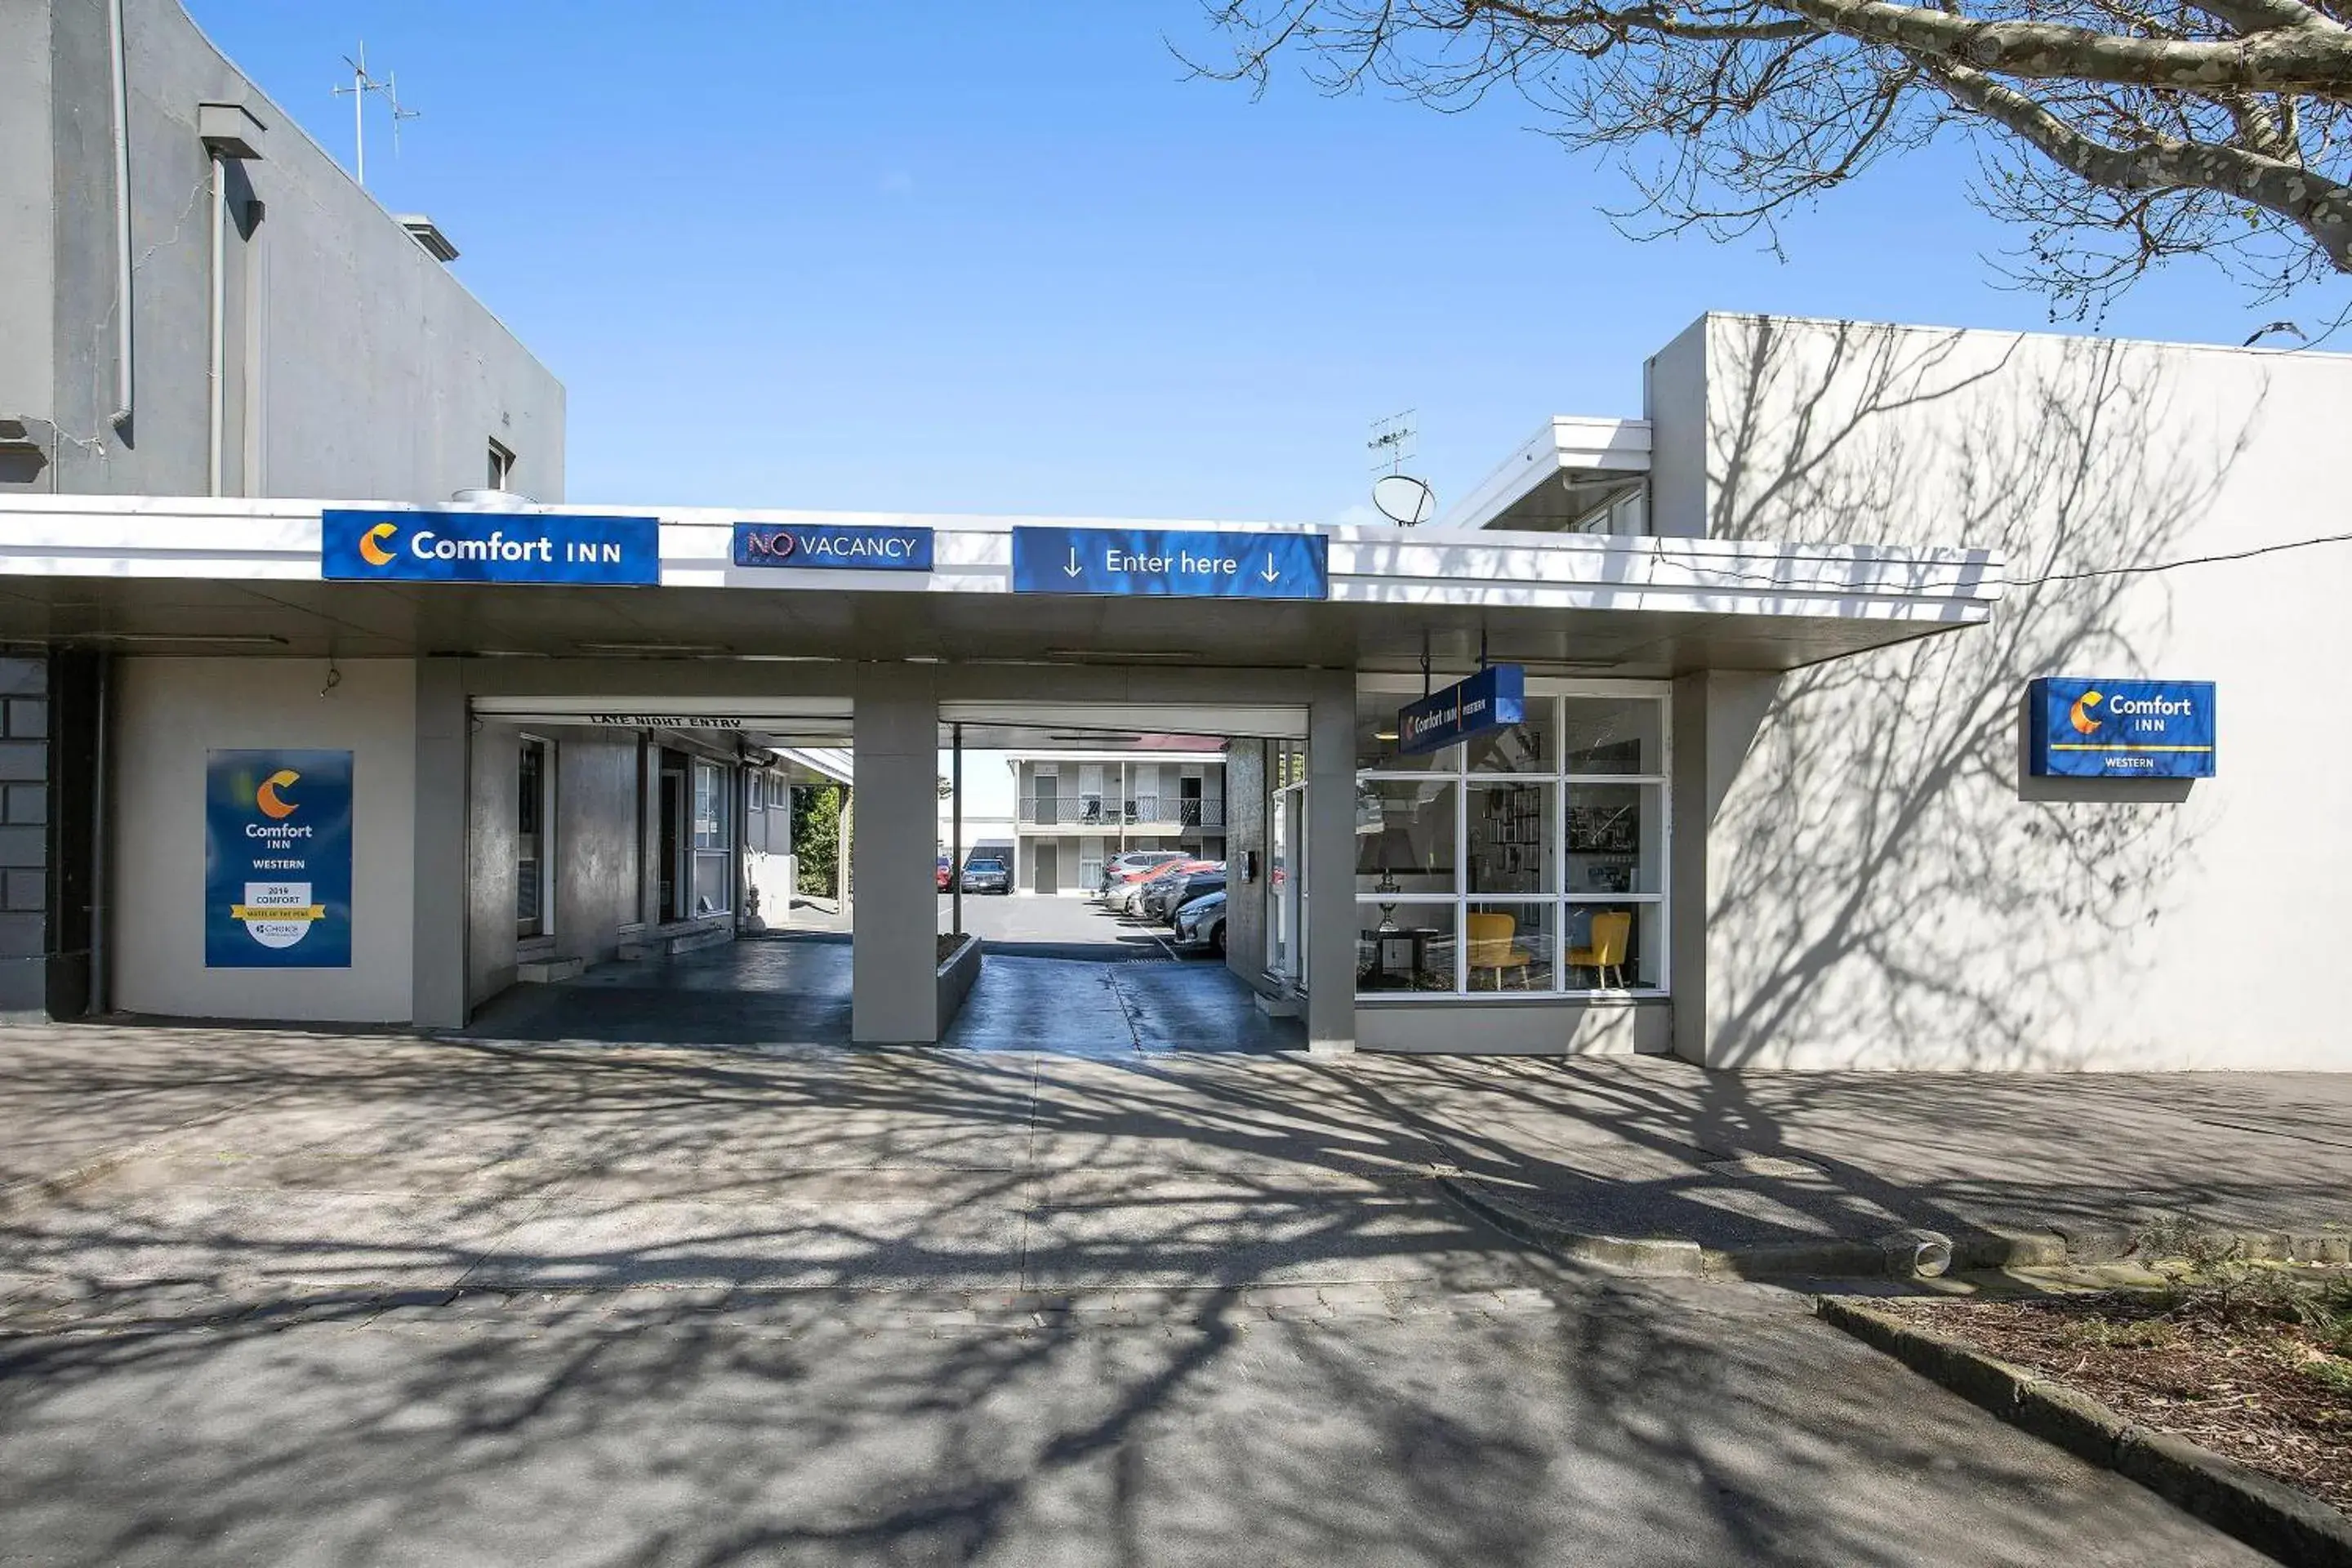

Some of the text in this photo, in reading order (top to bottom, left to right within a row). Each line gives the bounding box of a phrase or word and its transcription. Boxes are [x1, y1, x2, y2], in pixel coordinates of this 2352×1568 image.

[411, 531, 621, 563] Comfort INN
[749, 532, 917, 557] NO VACANCY
[1106, 550, 1238, 574] Enter here
[2109, 695, 2192, 715] Comfort
[589, 715, 742, 728] LATE NIGHT ENTRY
[1414, 709, 1443, 733] Comfort
[2135, 719, 2165, 732] INN
[2105, 757, 2154, 768] WESTERN
[246, 823, 313, 838] Comfort
[267, 840, 291, 849] INN
[252, 860, 305, 870] WESTERN
